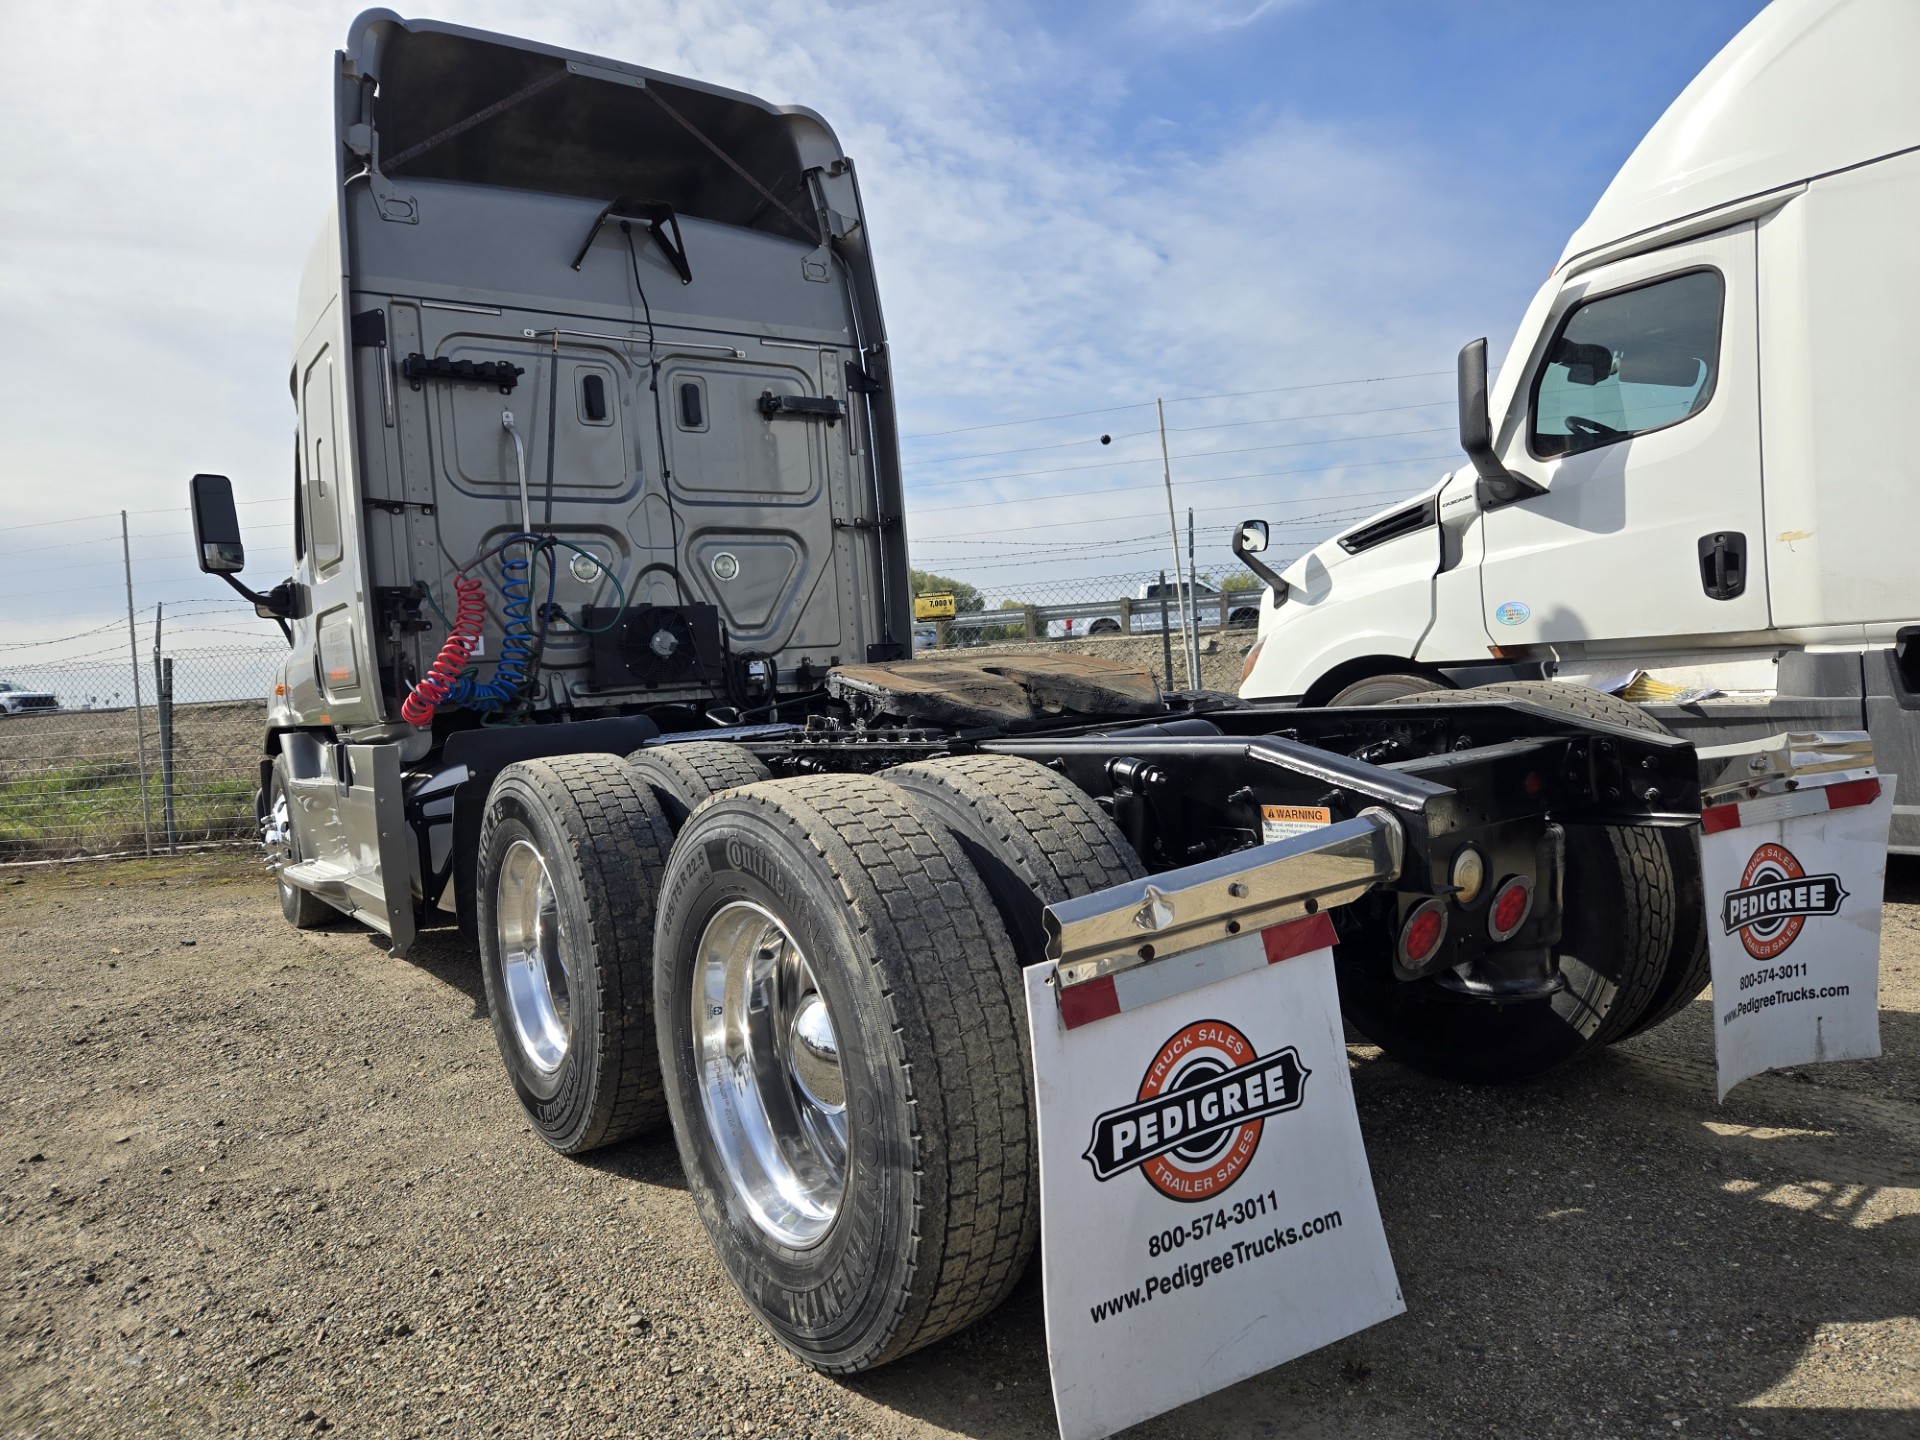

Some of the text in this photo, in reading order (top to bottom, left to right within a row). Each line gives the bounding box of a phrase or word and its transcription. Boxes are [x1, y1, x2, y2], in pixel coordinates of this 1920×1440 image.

[929, 600, 947, 608] 7,000
[1276, 809, 1323, 820] WARNING
[1744, 848, 1795, 881] TRUCK SALES
[663, 851, 706, 937] 295/75 R 22.5
[1730, 884, 1826, 925] PEDIGREE
[1744, 920, 1798, 954] TRAILER SALES
[1739, 963, 1807, 991] 800-574-3011
[1723, 985, 1850, 1026] www.PedigreeTrucks.com
[1147, 1028, 1246, 1089] TRUCK SALES
[1112, 1064, 1286, 1163] PEDIGREE
[1154, 1128, 1255, 1193] TRAILER SALES
[1148, 1190, 1279, 1259] 800-574-3011
[1090, 1209, 1343, 1325] www.PedigreeTrucks.com
